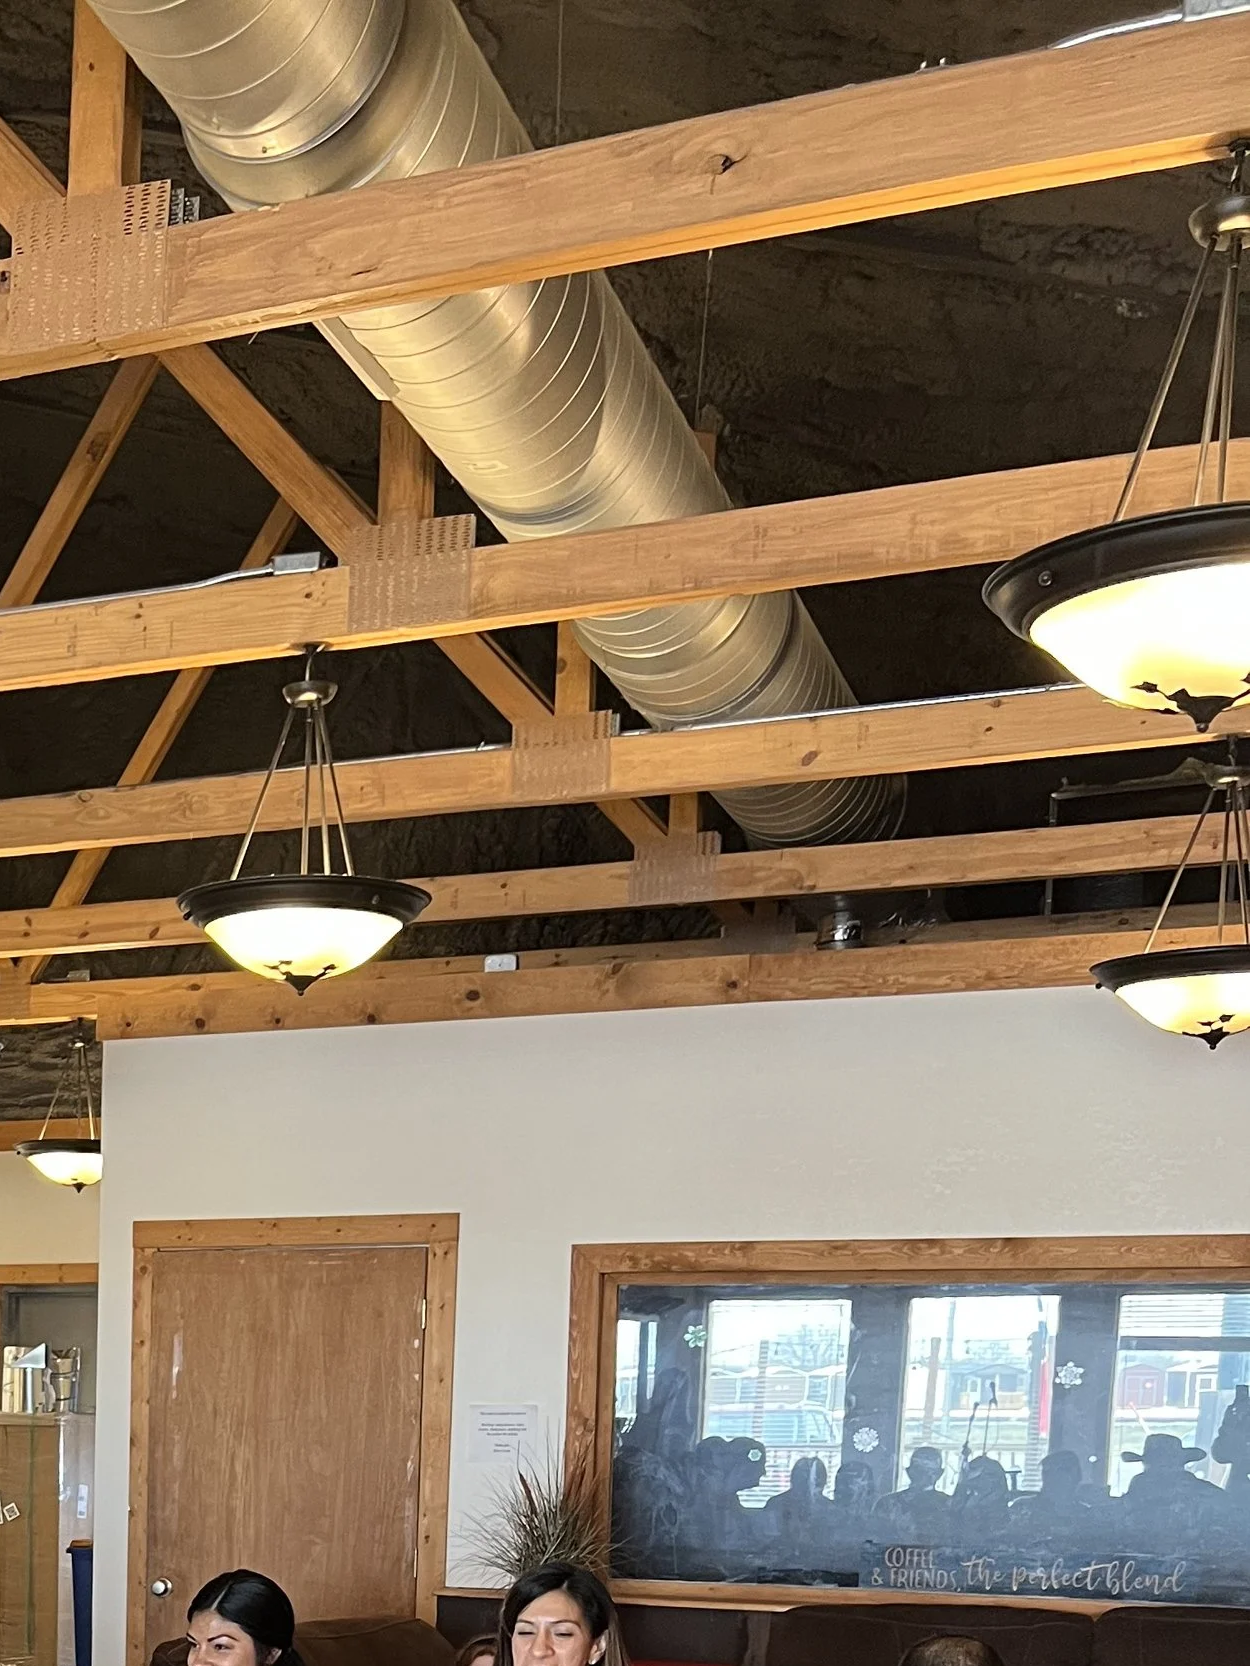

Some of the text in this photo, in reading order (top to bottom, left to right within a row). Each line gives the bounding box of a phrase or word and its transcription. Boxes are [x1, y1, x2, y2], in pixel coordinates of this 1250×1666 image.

[884, 1547, 935, 1568] COFFEE
[871, 1567, 884, 1586] &
[960, 1555, 1187, 1596] the perfect blend
